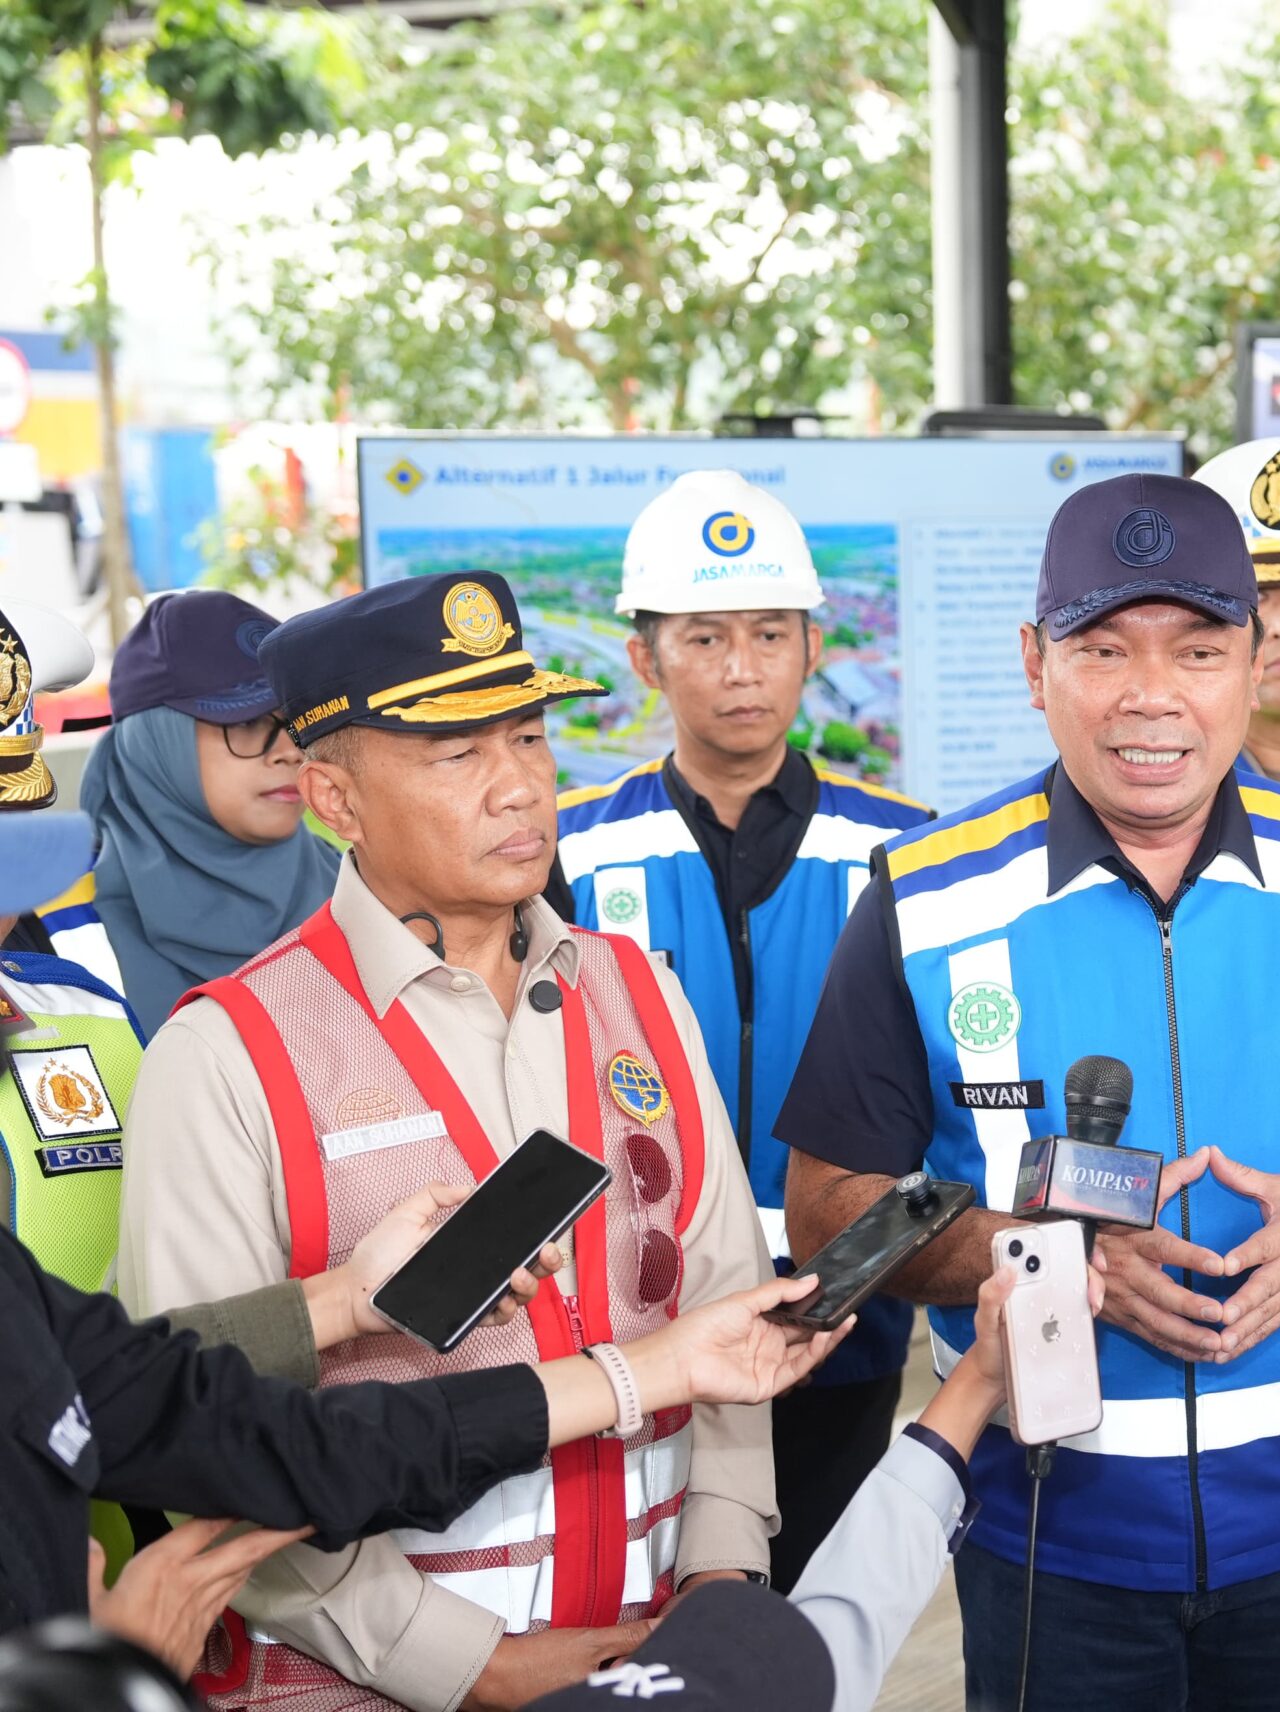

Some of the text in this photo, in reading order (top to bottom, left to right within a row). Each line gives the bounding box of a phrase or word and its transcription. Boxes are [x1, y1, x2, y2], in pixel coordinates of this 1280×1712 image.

[435, 464, 557, 486] Alternatif
[589, 464, 648, 486] Jalur
[305, 695, 350, 726] SUHANAN
[962, 1085, 1029, 1106] RIVAN
[368, 1114, 441, 1145] SUHANAN
[56, 1146, 123, 1166] POLR
